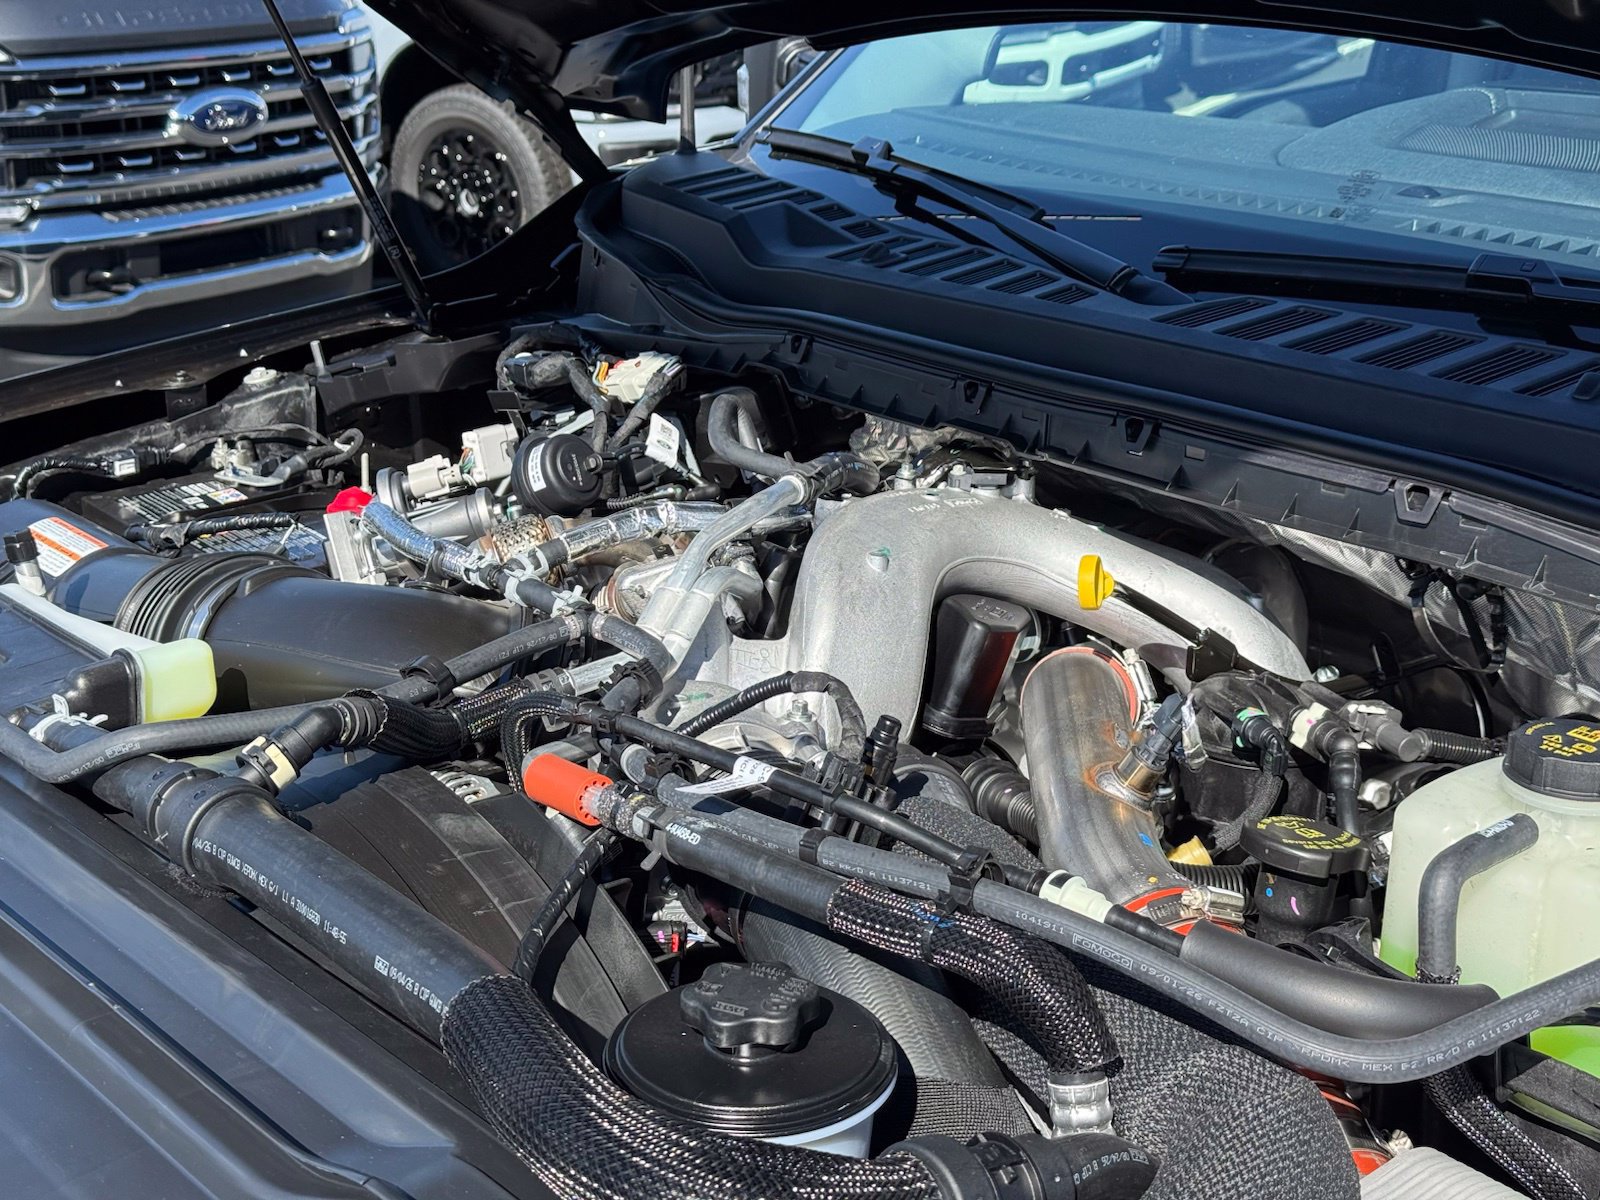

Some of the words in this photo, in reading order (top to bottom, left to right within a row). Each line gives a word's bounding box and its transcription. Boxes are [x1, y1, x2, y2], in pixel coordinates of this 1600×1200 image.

[1256, 1026, 1284, 1043] CIP
[1362, 1063, 1393, 1072] MEX
[1467, 1039, 1475, 1048] A
